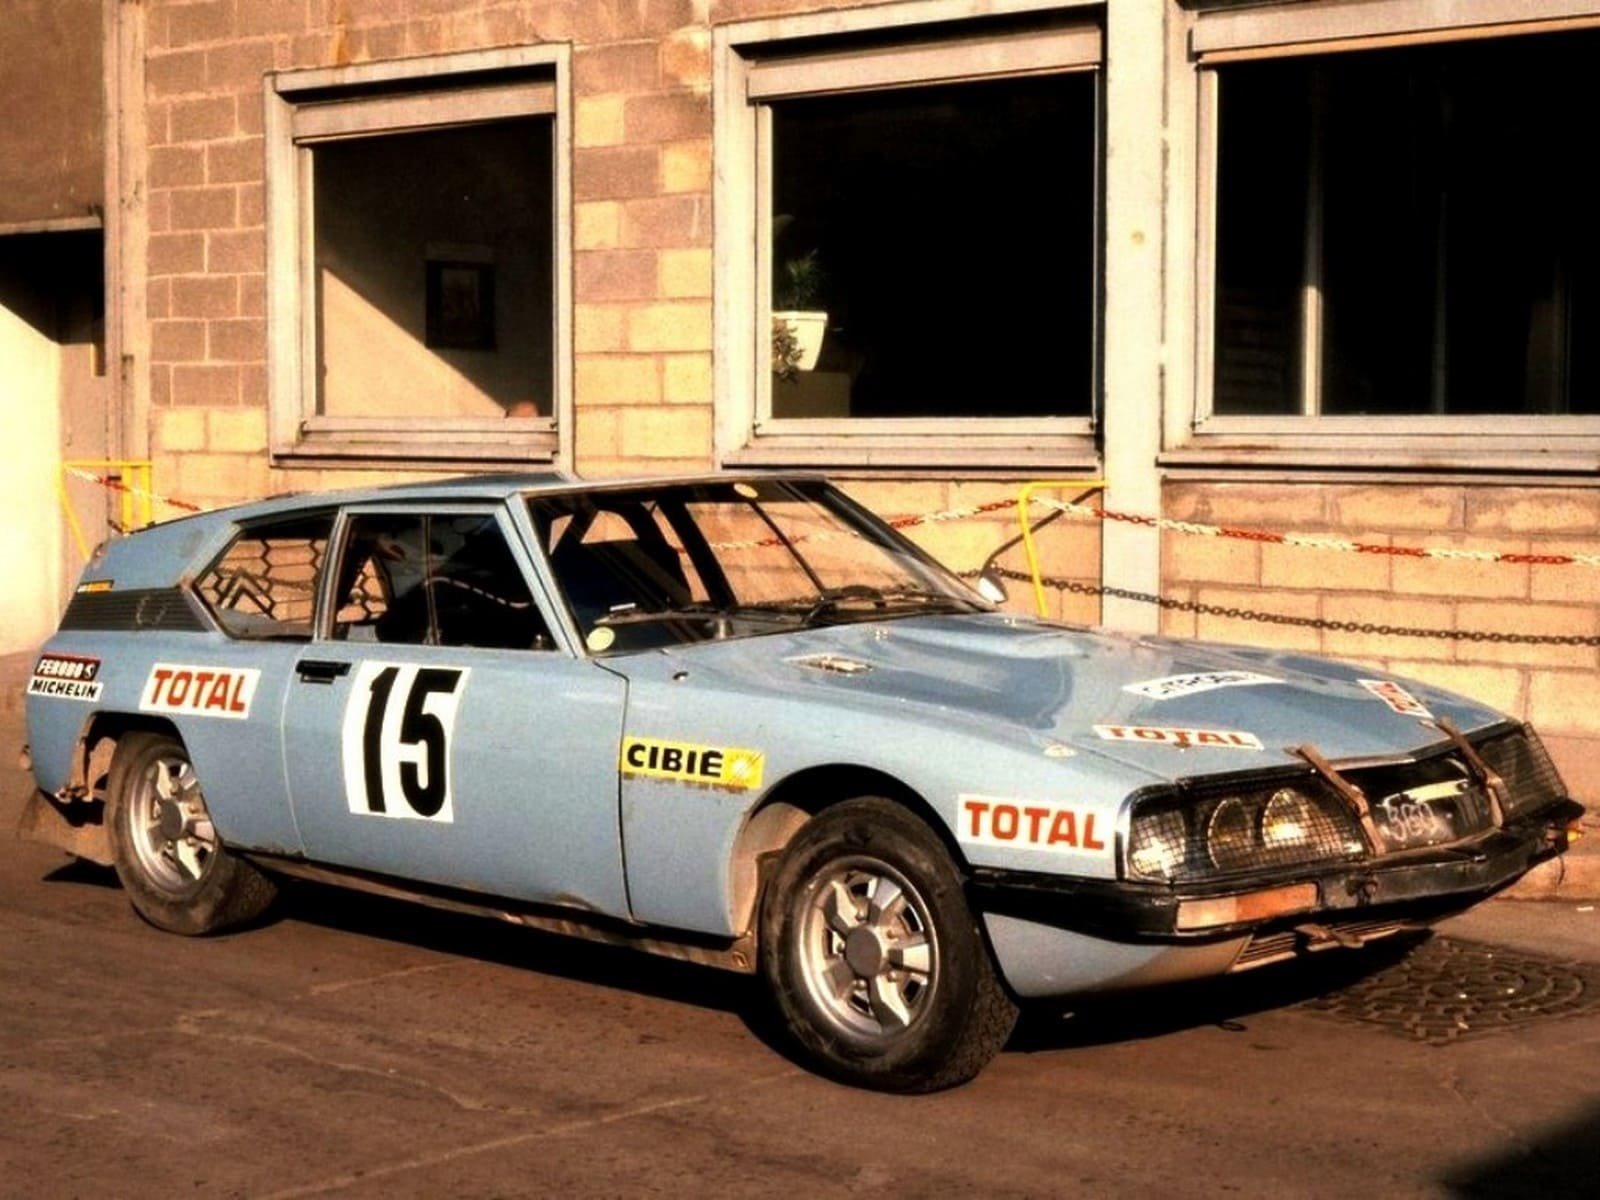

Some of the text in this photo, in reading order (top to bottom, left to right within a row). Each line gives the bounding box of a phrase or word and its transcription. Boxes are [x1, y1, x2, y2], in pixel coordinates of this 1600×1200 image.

[30, 679, 99, 699] MICHELIN
[150, 669, 246, 713] TOTAL
[362, 666, 463, 818] 15
[1107, 727, 1258, 749] TOTAL
[964, 801, 1105, 851] TOTAL
